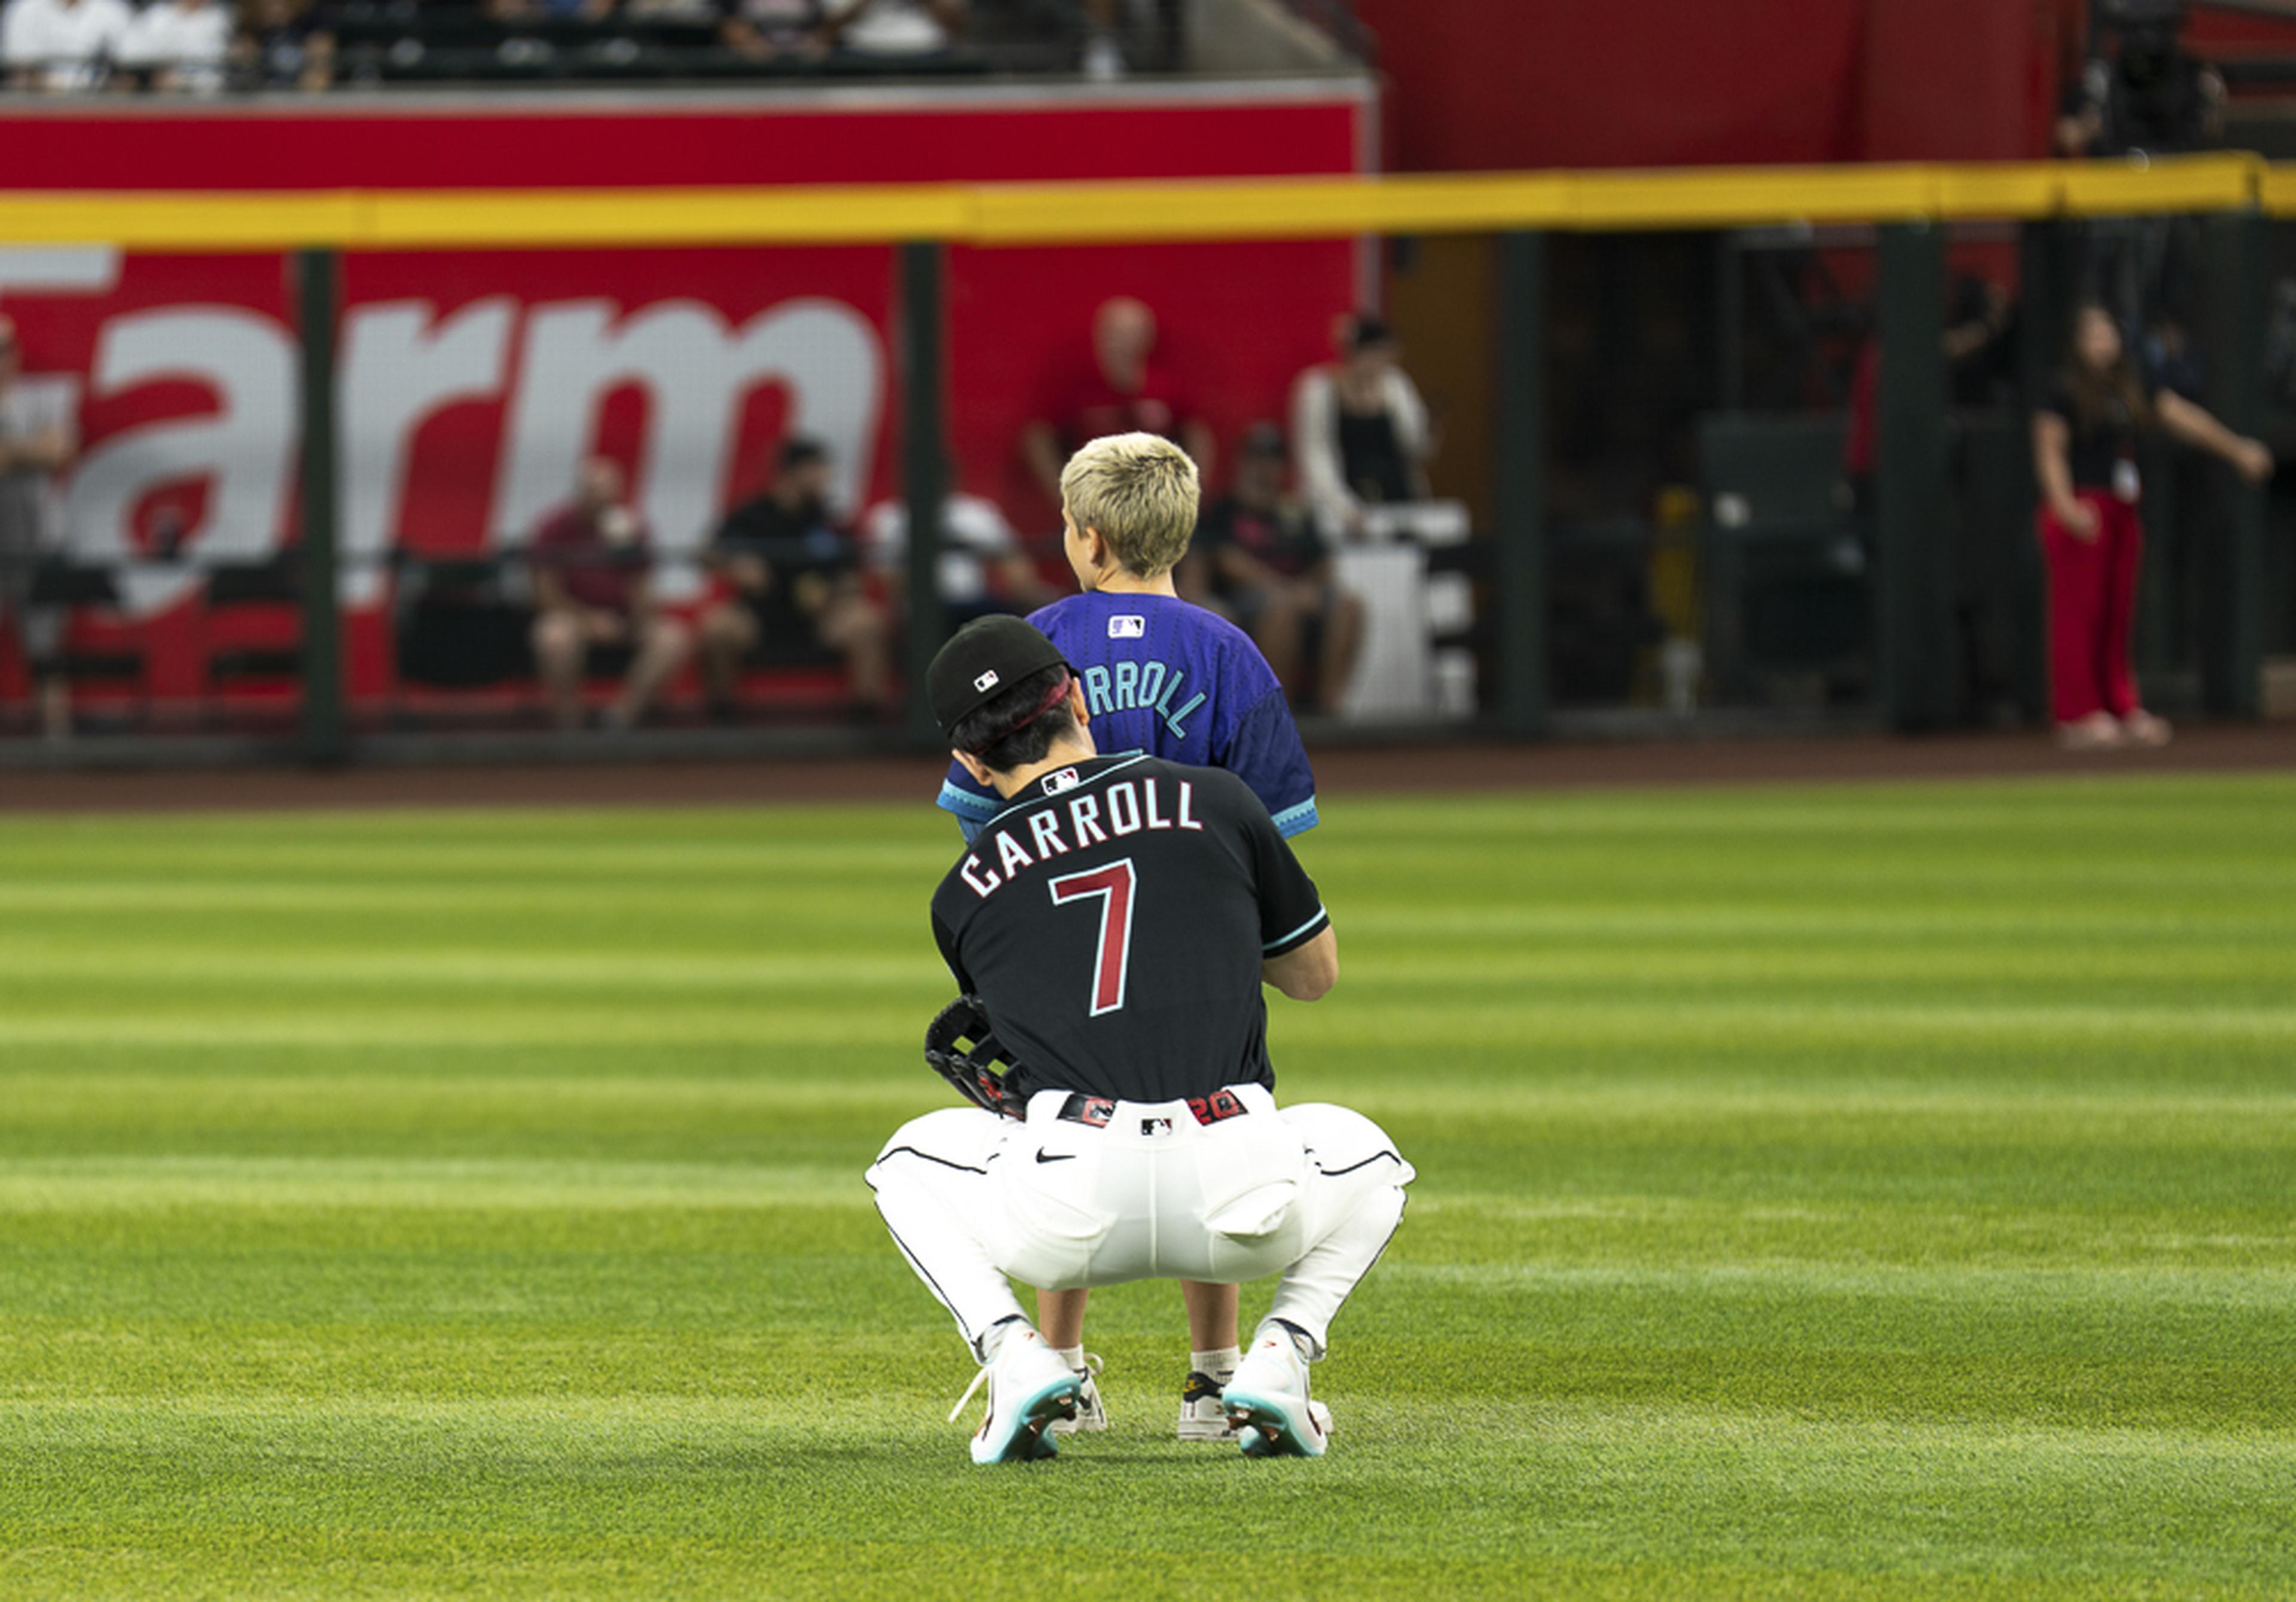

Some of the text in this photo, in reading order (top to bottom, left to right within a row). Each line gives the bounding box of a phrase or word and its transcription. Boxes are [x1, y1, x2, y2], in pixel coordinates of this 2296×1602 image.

[0, 242, 885, 619] arm
[1085, 661, 1207, 739] RROLL
[960, 778, 1203, 898] CARROLL
[1048, 857, 1137, 1017] 7
